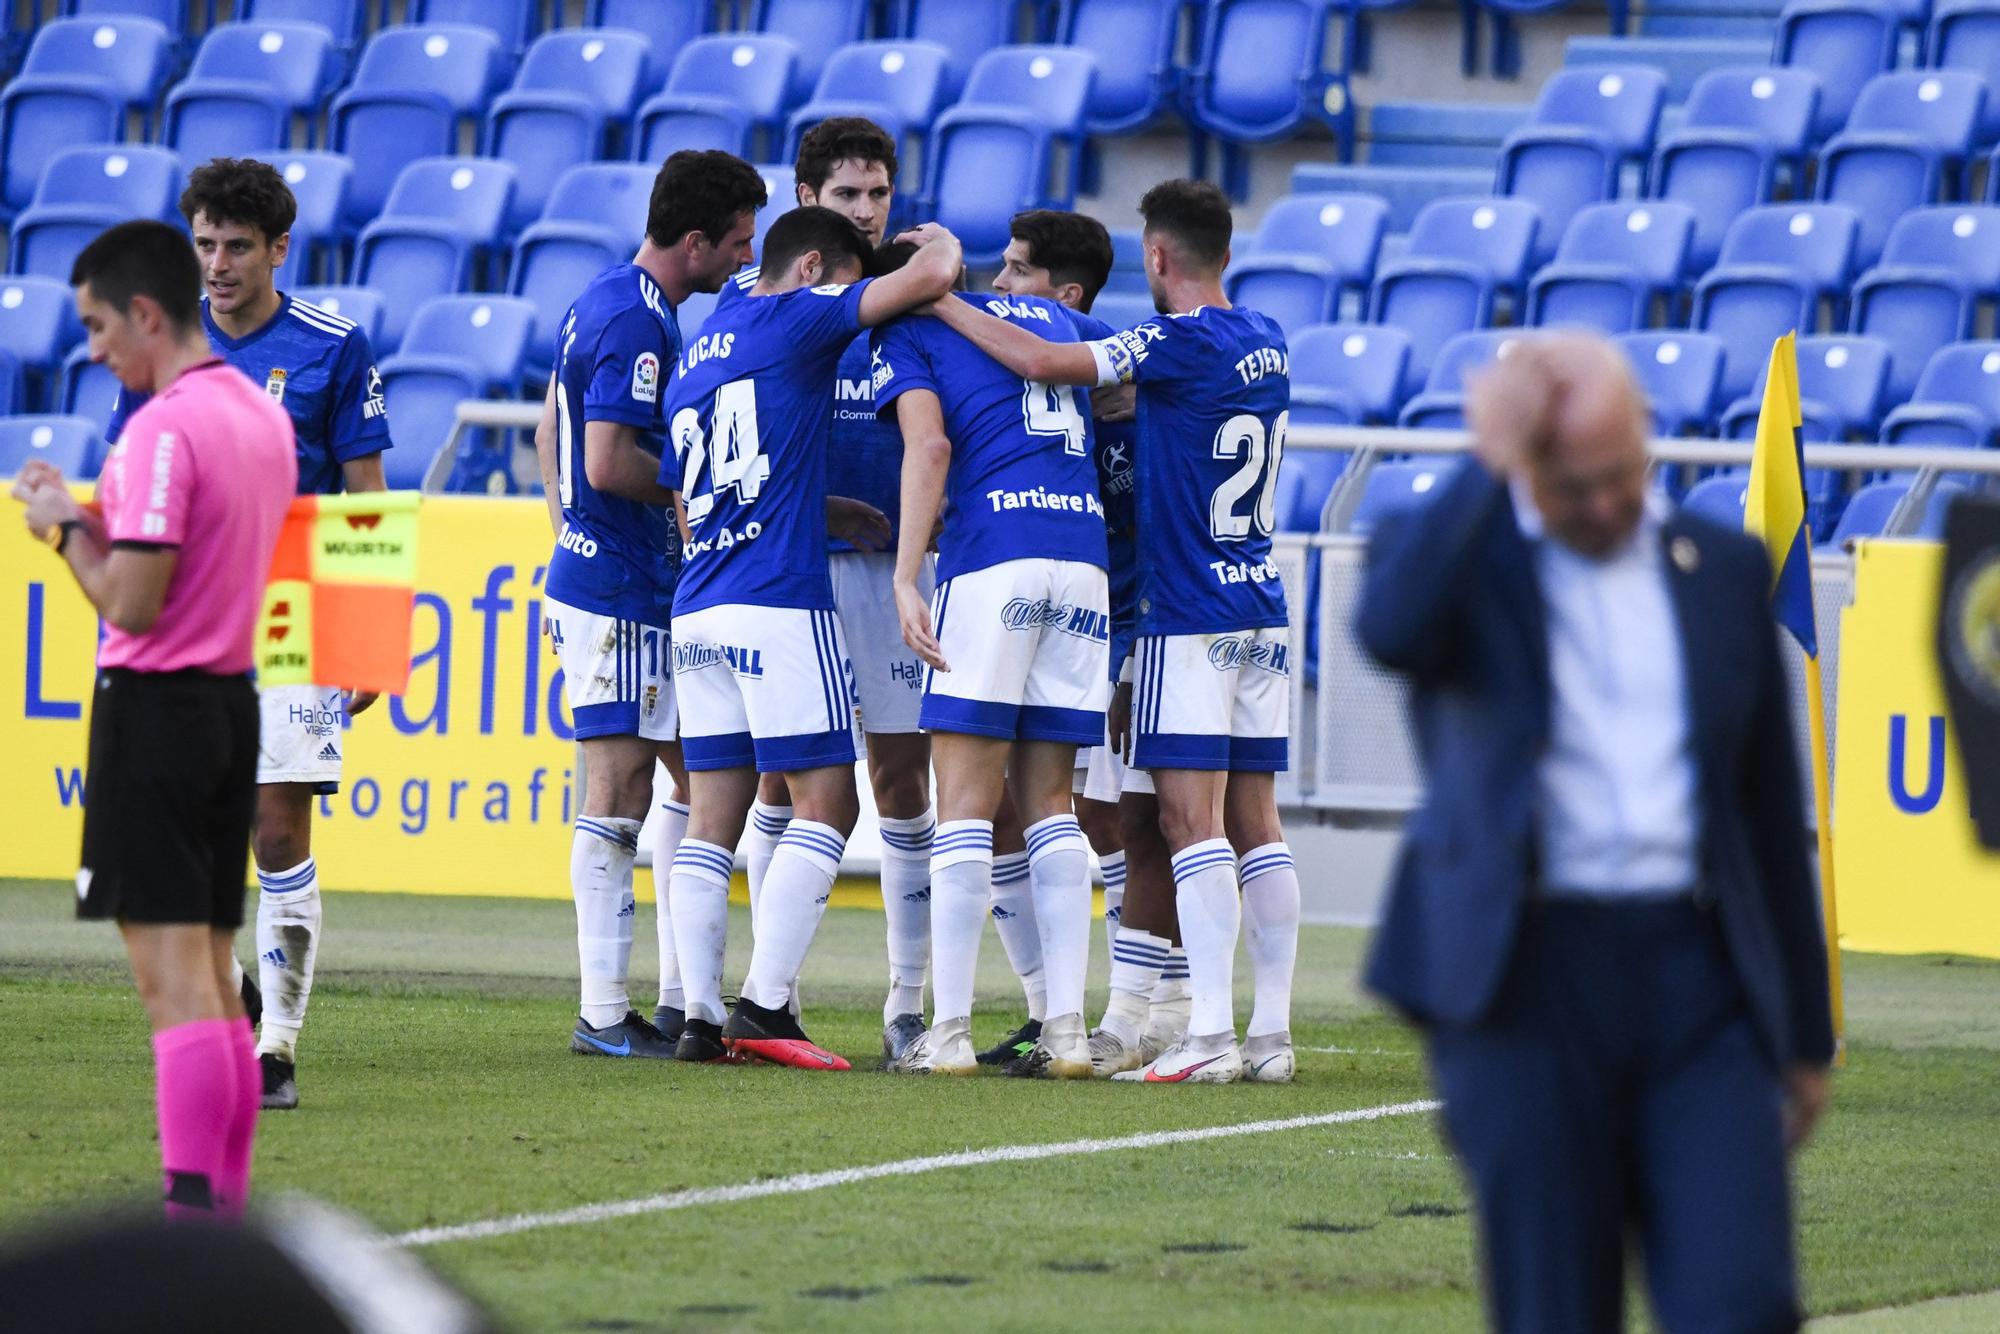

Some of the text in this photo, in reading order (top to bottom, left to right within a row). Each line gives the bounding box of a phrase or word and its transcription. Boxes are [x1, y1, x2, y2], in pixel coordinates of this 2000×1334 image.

[678, 332, 736, 381] LUCAS
[363, 397, 387, 419] INTE
[840, 409, 877, 420] Comm
[1022, 378, 1087, 457] 4
[669, 379, 770, 528] 24
[987, 485, 1084, 513] Tartiere
